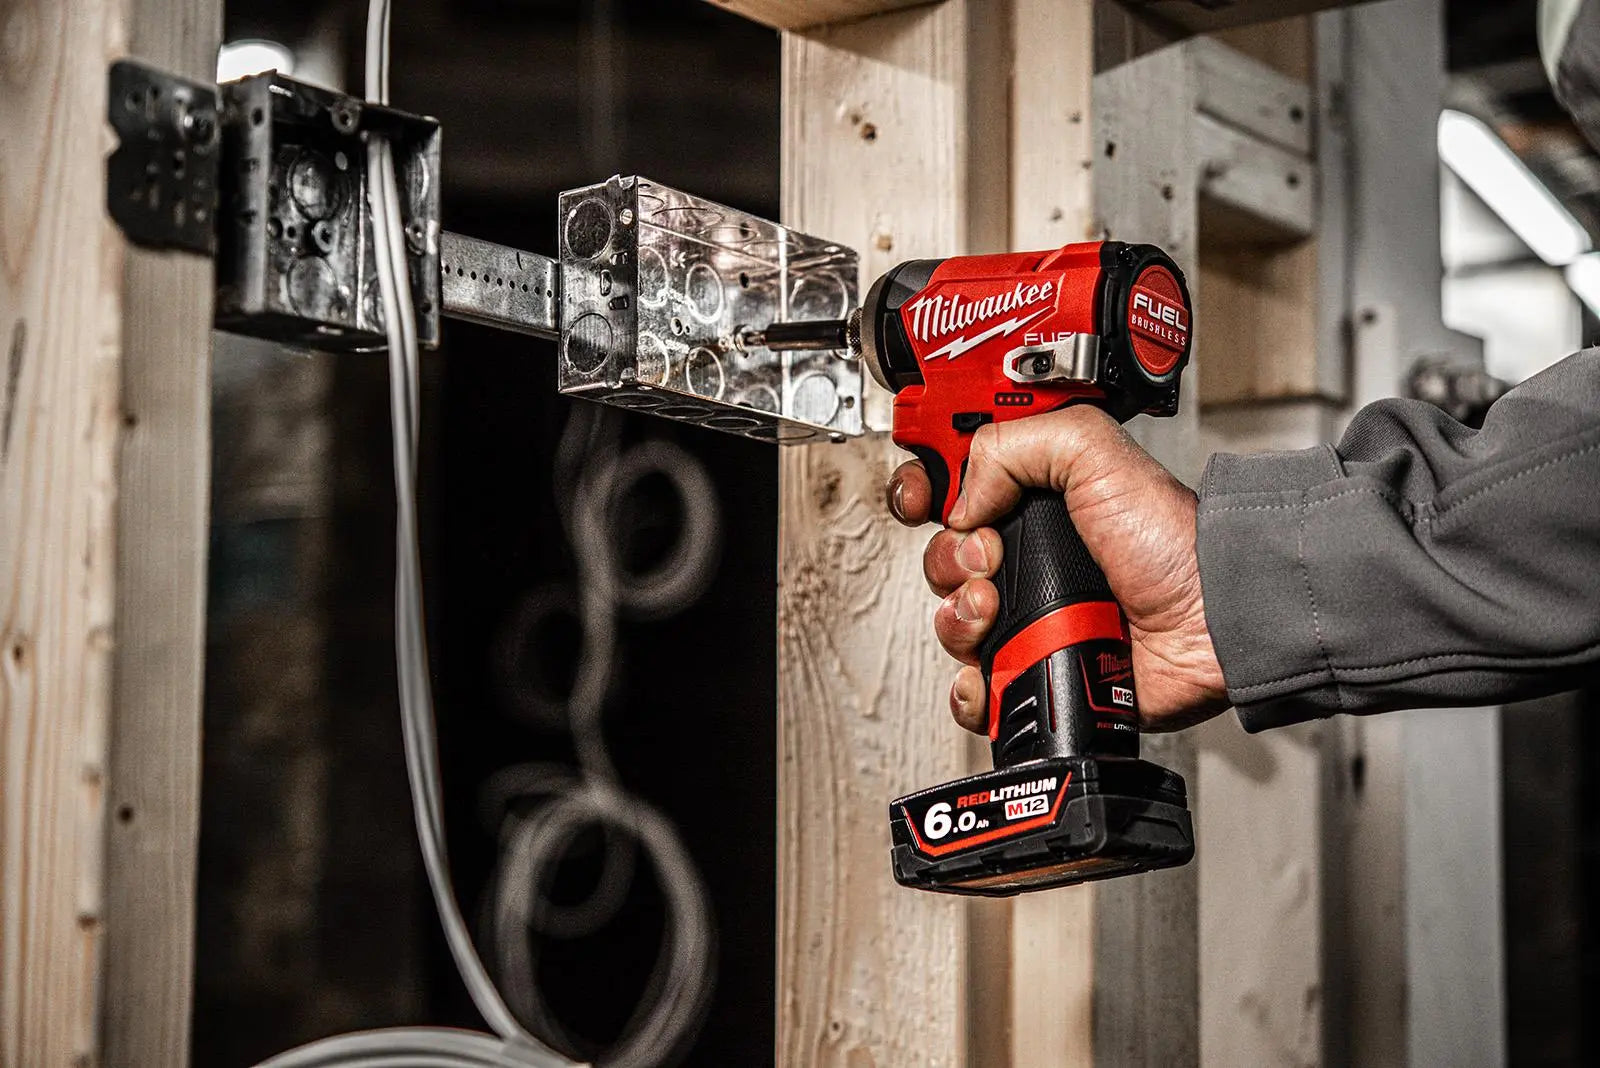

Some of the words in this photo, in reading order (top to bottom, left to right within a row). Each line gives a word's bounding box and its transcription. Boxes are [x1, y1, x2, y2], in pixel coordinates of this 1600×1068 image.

[908, 281, 1054, 342] Milwaukee
[1133, 292, 1187, 332] FUEL
[1024, 331, 1077, 346] FUE
[1131, 313, 1186, 346] BRUSHLESS
[1113, 689, 1132, 703] M12
[957, 777, 1057, 808] REDLITHIUM
[1007, 799, 1044, 817] M12
